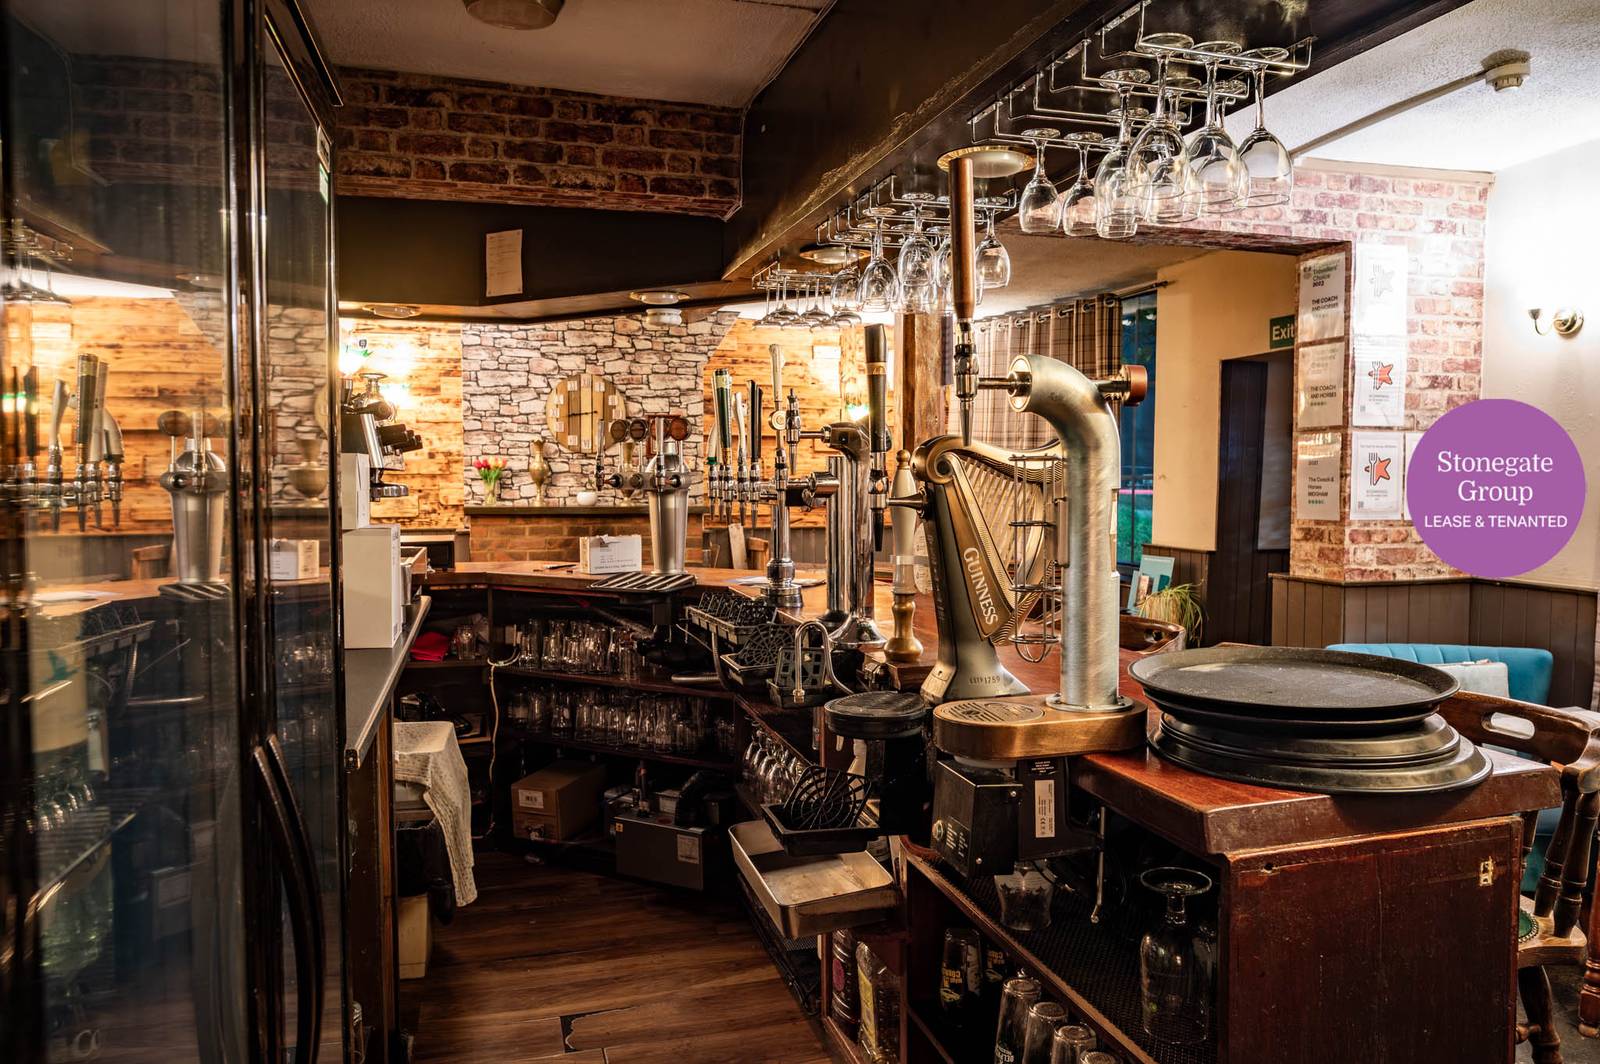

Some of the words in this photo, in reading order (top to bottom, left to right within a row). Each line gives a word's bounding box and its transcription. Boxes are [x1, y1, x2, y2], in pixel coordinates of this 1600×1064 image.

[1321, 295, 1338, 303] COACH
[1272, 323, 1295, 341] Exit
[963, 547, 998, 625] GUINNESS
[984, 675, 1001, 684] 1759
